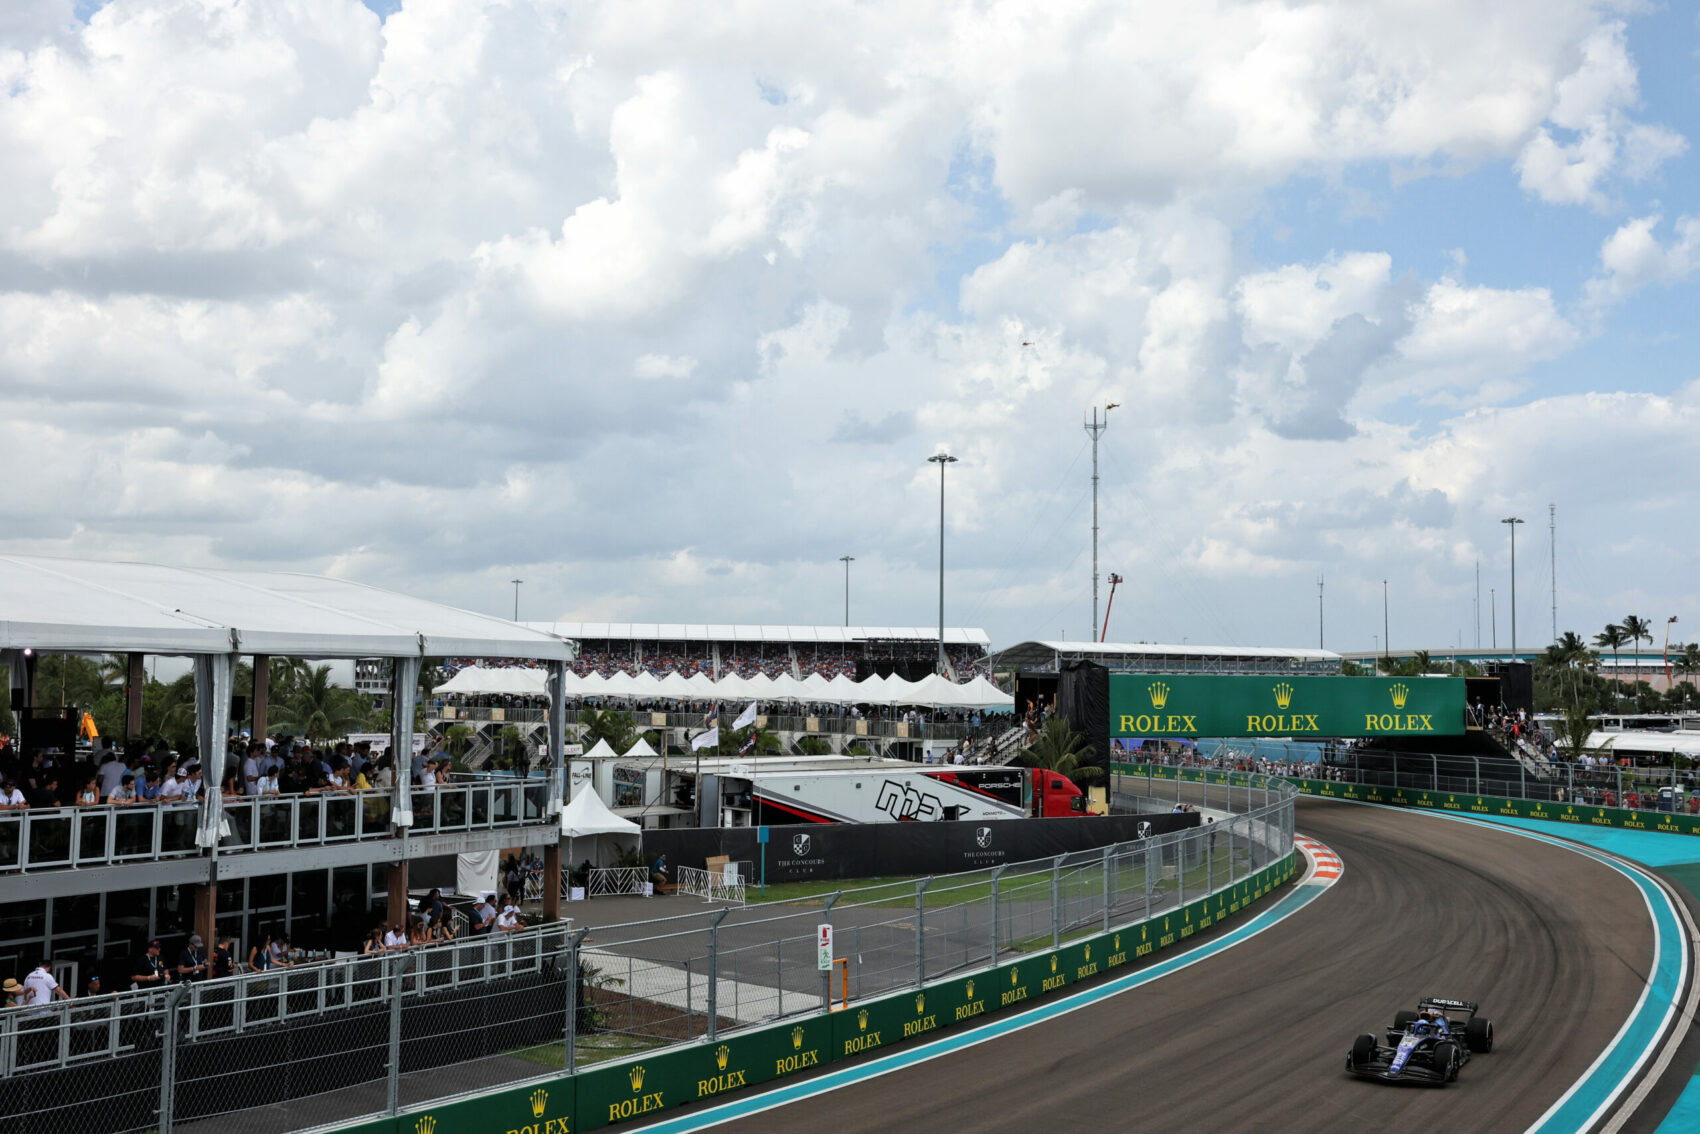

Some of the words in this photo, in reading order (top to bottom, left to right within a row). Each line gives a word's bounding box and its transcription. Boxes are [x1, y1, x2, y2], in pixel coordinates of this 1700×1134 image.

[1120, 715, 1197, 733] ROLEX
[1247, 715, 1320, 732] ROLEX
[1365, 714, 1433, 731] ROLEX
[1560, 813, 1580, 822] ROLEX
[1592, 816, 1612, 825] ROLEX
[1624, 820, 1645, 829] ROLEX
[1657, 823, 1679, 832] ROLEX
[964, 851, 975, 859] THE
[1137, 941, 1153, 956] ROLEX
[1109, 950, 1126, 967] ROLEX
[1079, 960, 1098, 979] ROLEX
[1043, 973, 1065, 992] ROLEX
[1001, 985, 1027, 1006] ROLEX
[954, 998, 985, 1020] ROLEX
[904, 1015, 937, 1037] ROLEX
[845, 1031, 881, 1055] ROLEX
[776, 1049, 819, 1075] ROLEX
[697, 1069, 746, 1097] ROLEX
[609, 1091, 665, 1121] ROLEX
